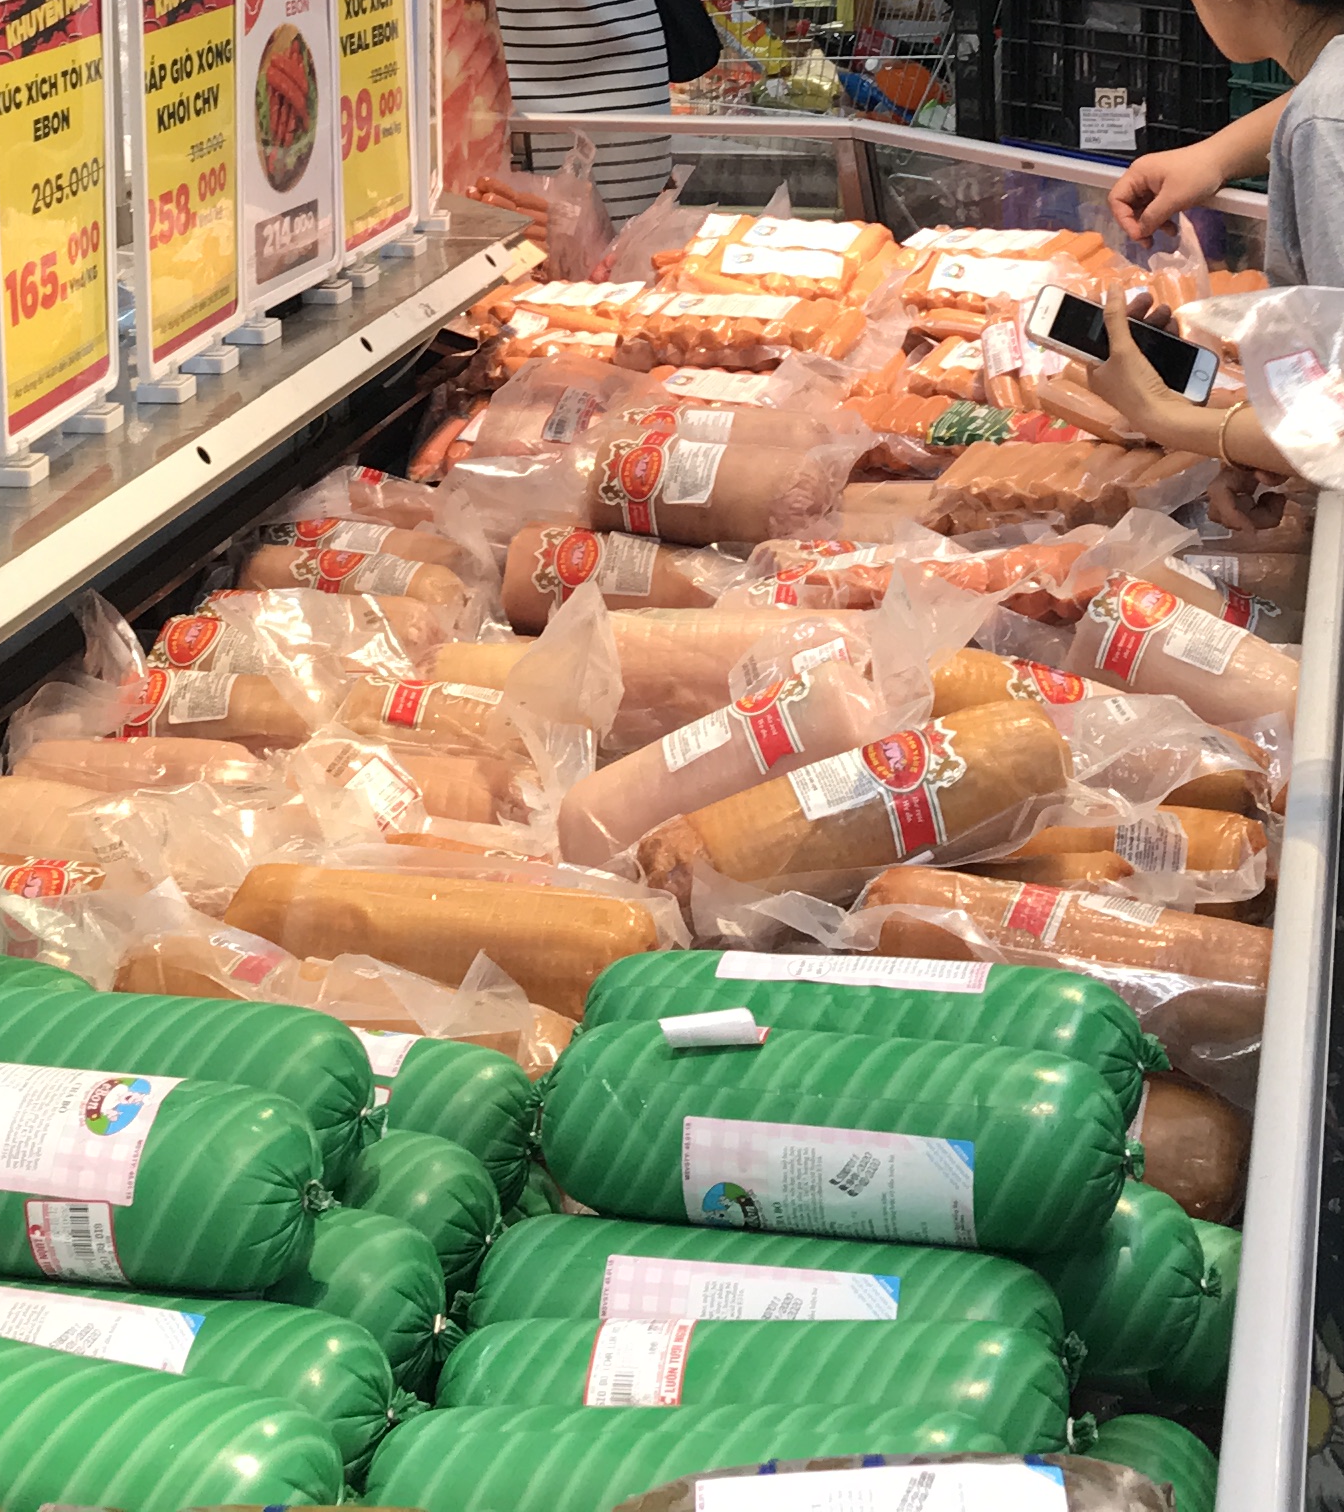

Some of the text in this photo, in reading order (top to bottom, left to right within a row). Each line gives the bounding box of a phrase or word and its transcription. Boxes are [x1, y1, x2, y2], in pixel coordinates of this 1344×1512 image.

[340, 25, 370, 58] VEAL
[26, 71, 58, 107] XÍCH
[61, 60, 83, 90] TỎI
[170, 47, 194, 85] GIÒ
[157, 84, 220, 133] KHÓI CHV
[380, 86, 402, 118] 000
[33, 107, 71, 142] EBON
[31, 157, 102, 215] 205.000
[198, 161, 227, 202] 000
[4, 220, 100, 328] 165. 000
[663, 1366, 679, 1393] LUÔN
